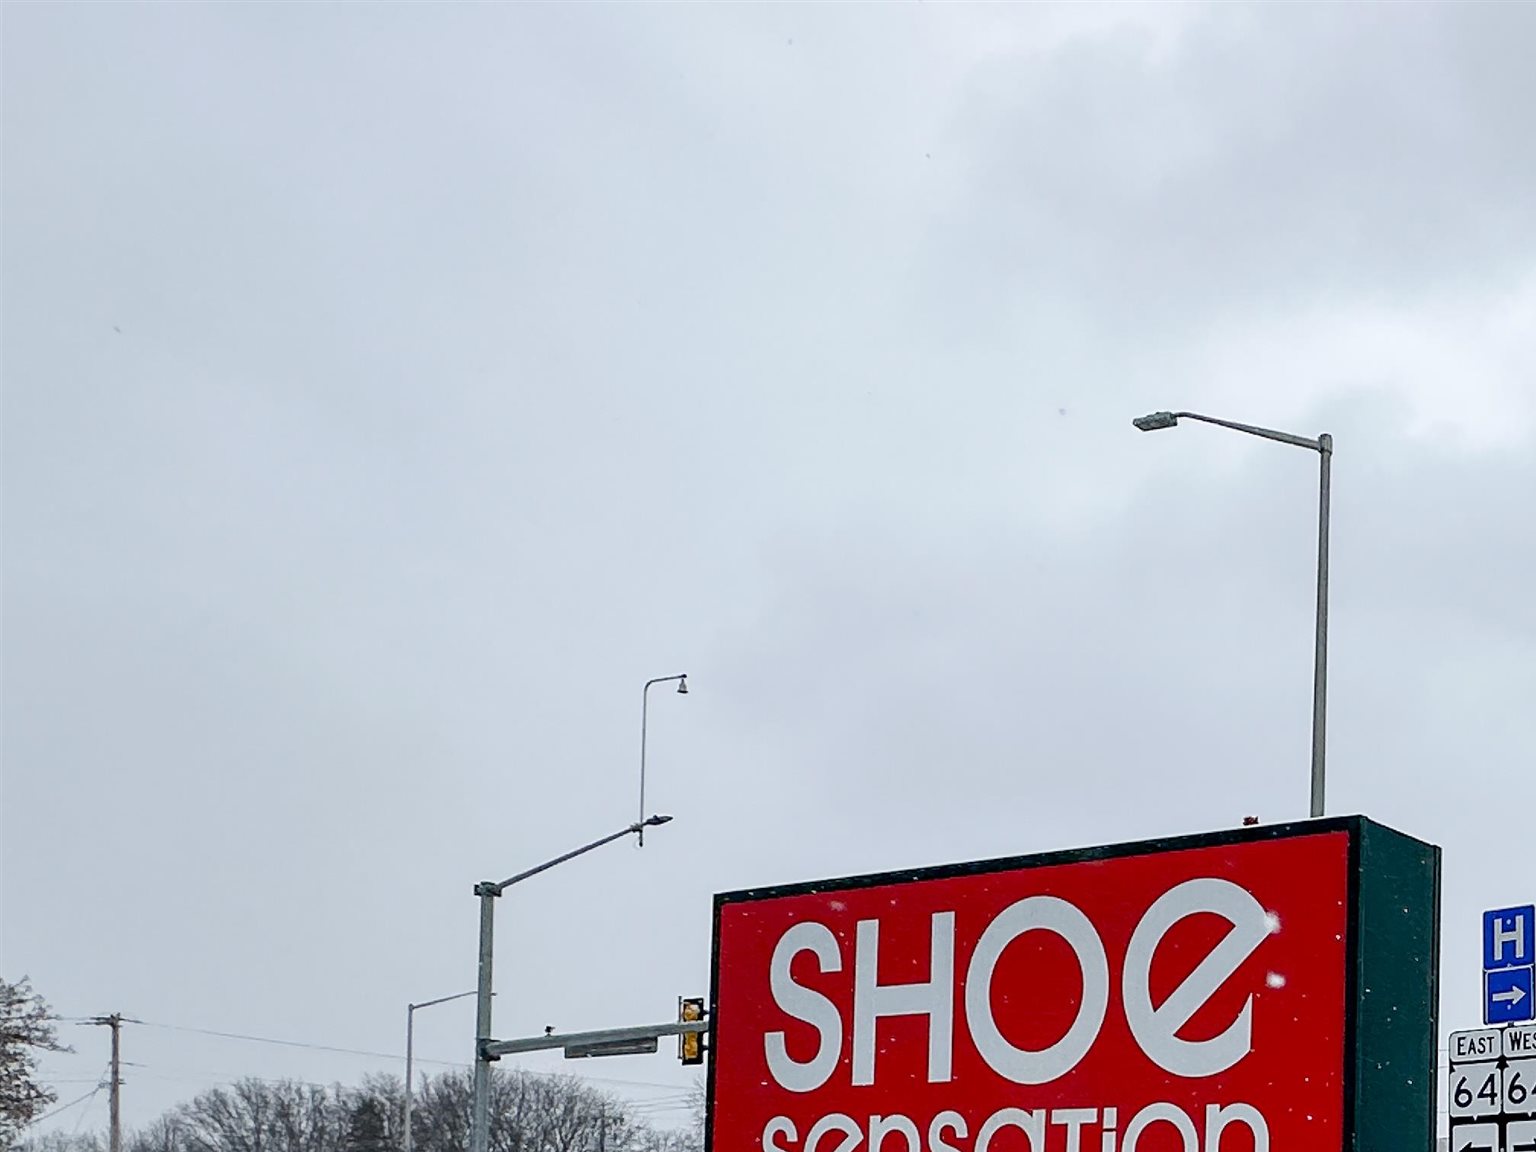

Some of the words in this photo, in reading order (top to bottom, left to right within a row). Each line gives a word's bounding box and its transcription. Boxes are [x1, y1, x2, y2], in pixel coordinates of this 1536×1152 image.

[1493, 914, 1525, 961] H
[1457, 1036, 1495, 1056] EAST
[1454, 1073, 1498, 1108] 64
